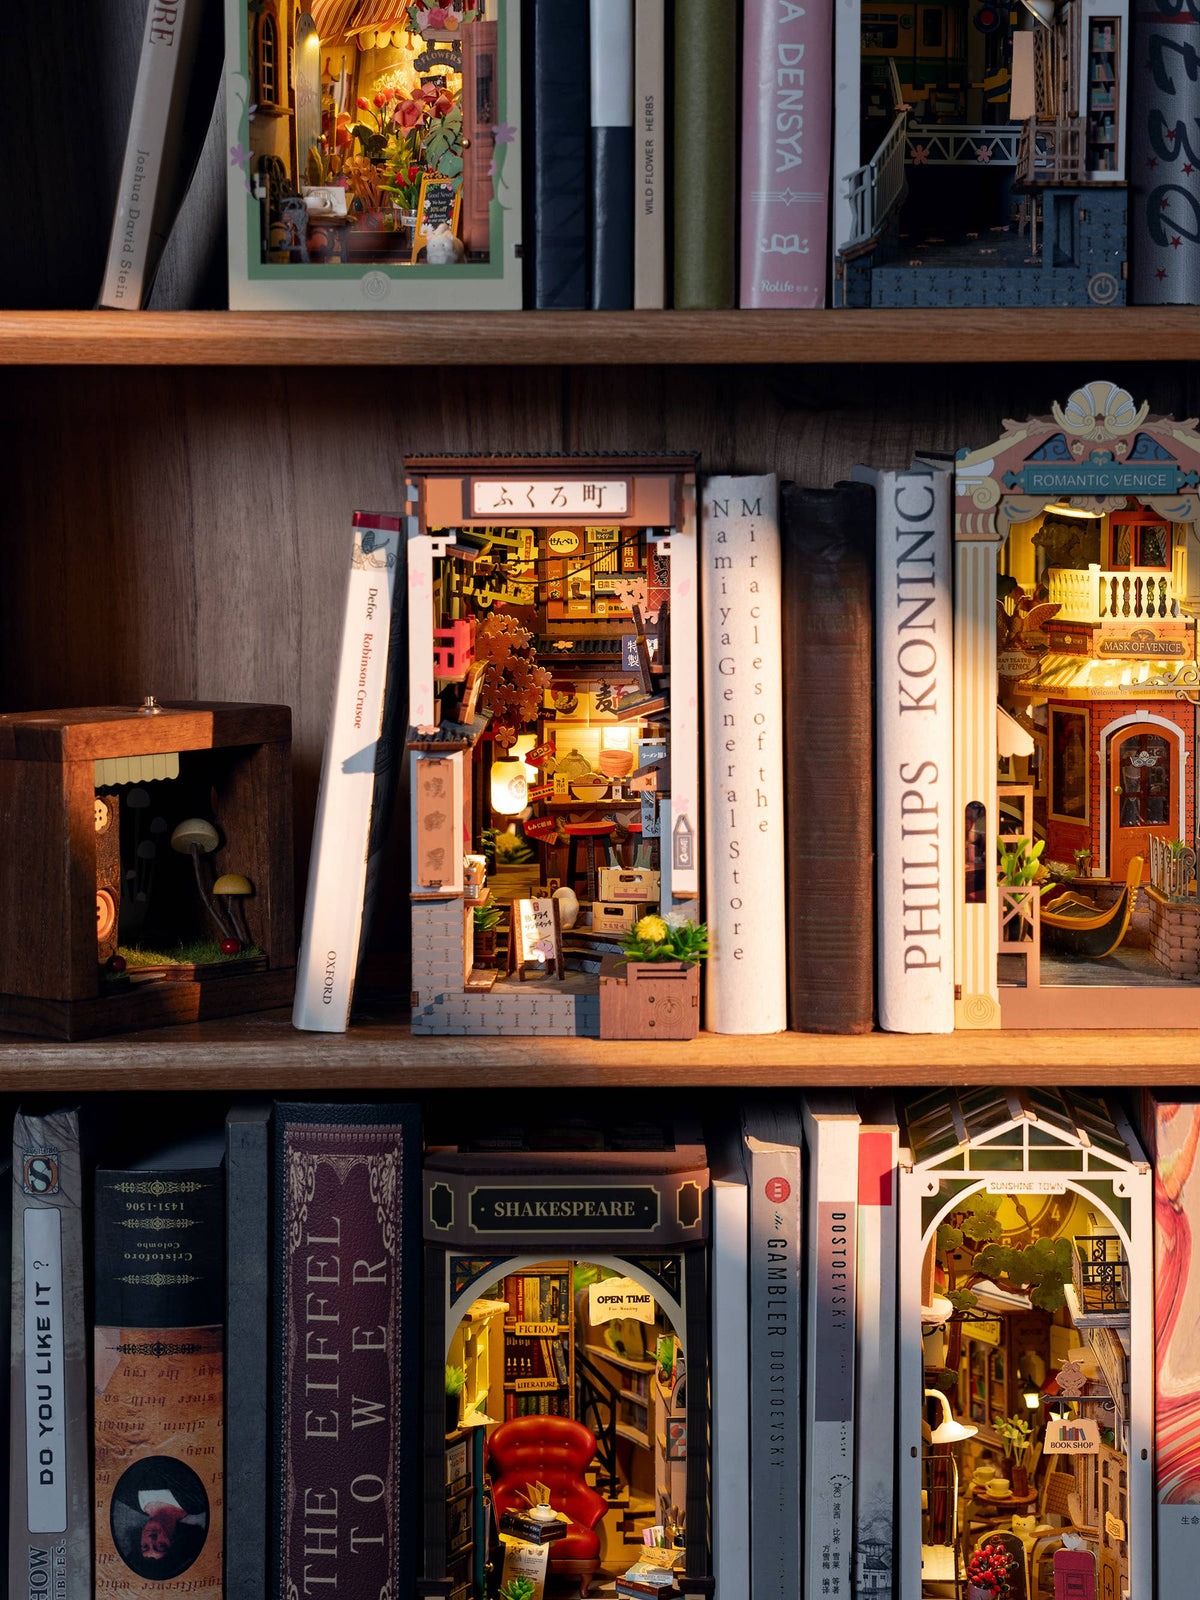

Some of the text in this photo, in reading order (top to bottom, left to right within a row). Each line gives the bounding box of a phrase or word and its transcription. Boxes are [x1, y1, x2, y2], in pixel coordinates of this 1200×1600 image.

[149, 0, 179, 46] RE
[420, 51, 462, 65] FLOWERS
[775, 43, 805, 173] DENSYA
[645, 95, 654, 216] WILD FLOWER HERBS
[115, 149, 150, 299] Joshua David Stein
[761, 280, 794, 293] Rolife
[1033, 474, 1167, 487] ROMANTIC VENICE
[492, 483, 608, 509] ふくろ町
[549, 537, 578, 546] せんべい
[353, 587, 378, 729] Defoe Robinson Crusoe
[1104, 641, 1182, 653] MASK OF VENICE
[741, 498, 769, 833] Miracles of the
[712, 498, 744, 961] Namiya General Store
[898, 760, 941, 973] PHILIPS
[322, 950, 337, 1005] OXFORD
[990, 1182, 1063, 1190] SUNSHINE TOWN
[126, 1202, 185, 1211] 1451-1506
[494, 1200, 636, 1218] SHAKESPEARE
[1051, 1203, 1061, 1221] 4
[123, 1252, 193, 1262] Cristoforo
[136, 1241, 181, 1249] Colombo
[831, 1212, 847, 1331] DOSTOEVSKY
[34, 1281, 51, 1306] IT
[597, 1294, 651, 1304] OPEN TIME
[767, 1238, 787, 1337] GAMBLER
[519, 1325, 556, 1334] FICTION
[36, 1316, 52, 1374] LIKE
[517, 1381, 556, 1389] LITERATURE
[37, 1384, 54, 1438] YOU
[302, 1216, 341, 1595] THE EIFFEL
[350, 1256, 387, 1555] TOWER
[770, 1351, 785, 1468] DOSTOEVSKY
[1050, 1441, 1094, 1449] BOOK SHOP
[38, 1449, 53, 1485] DO
[1180, 1515, 1200, 1525] 生命
